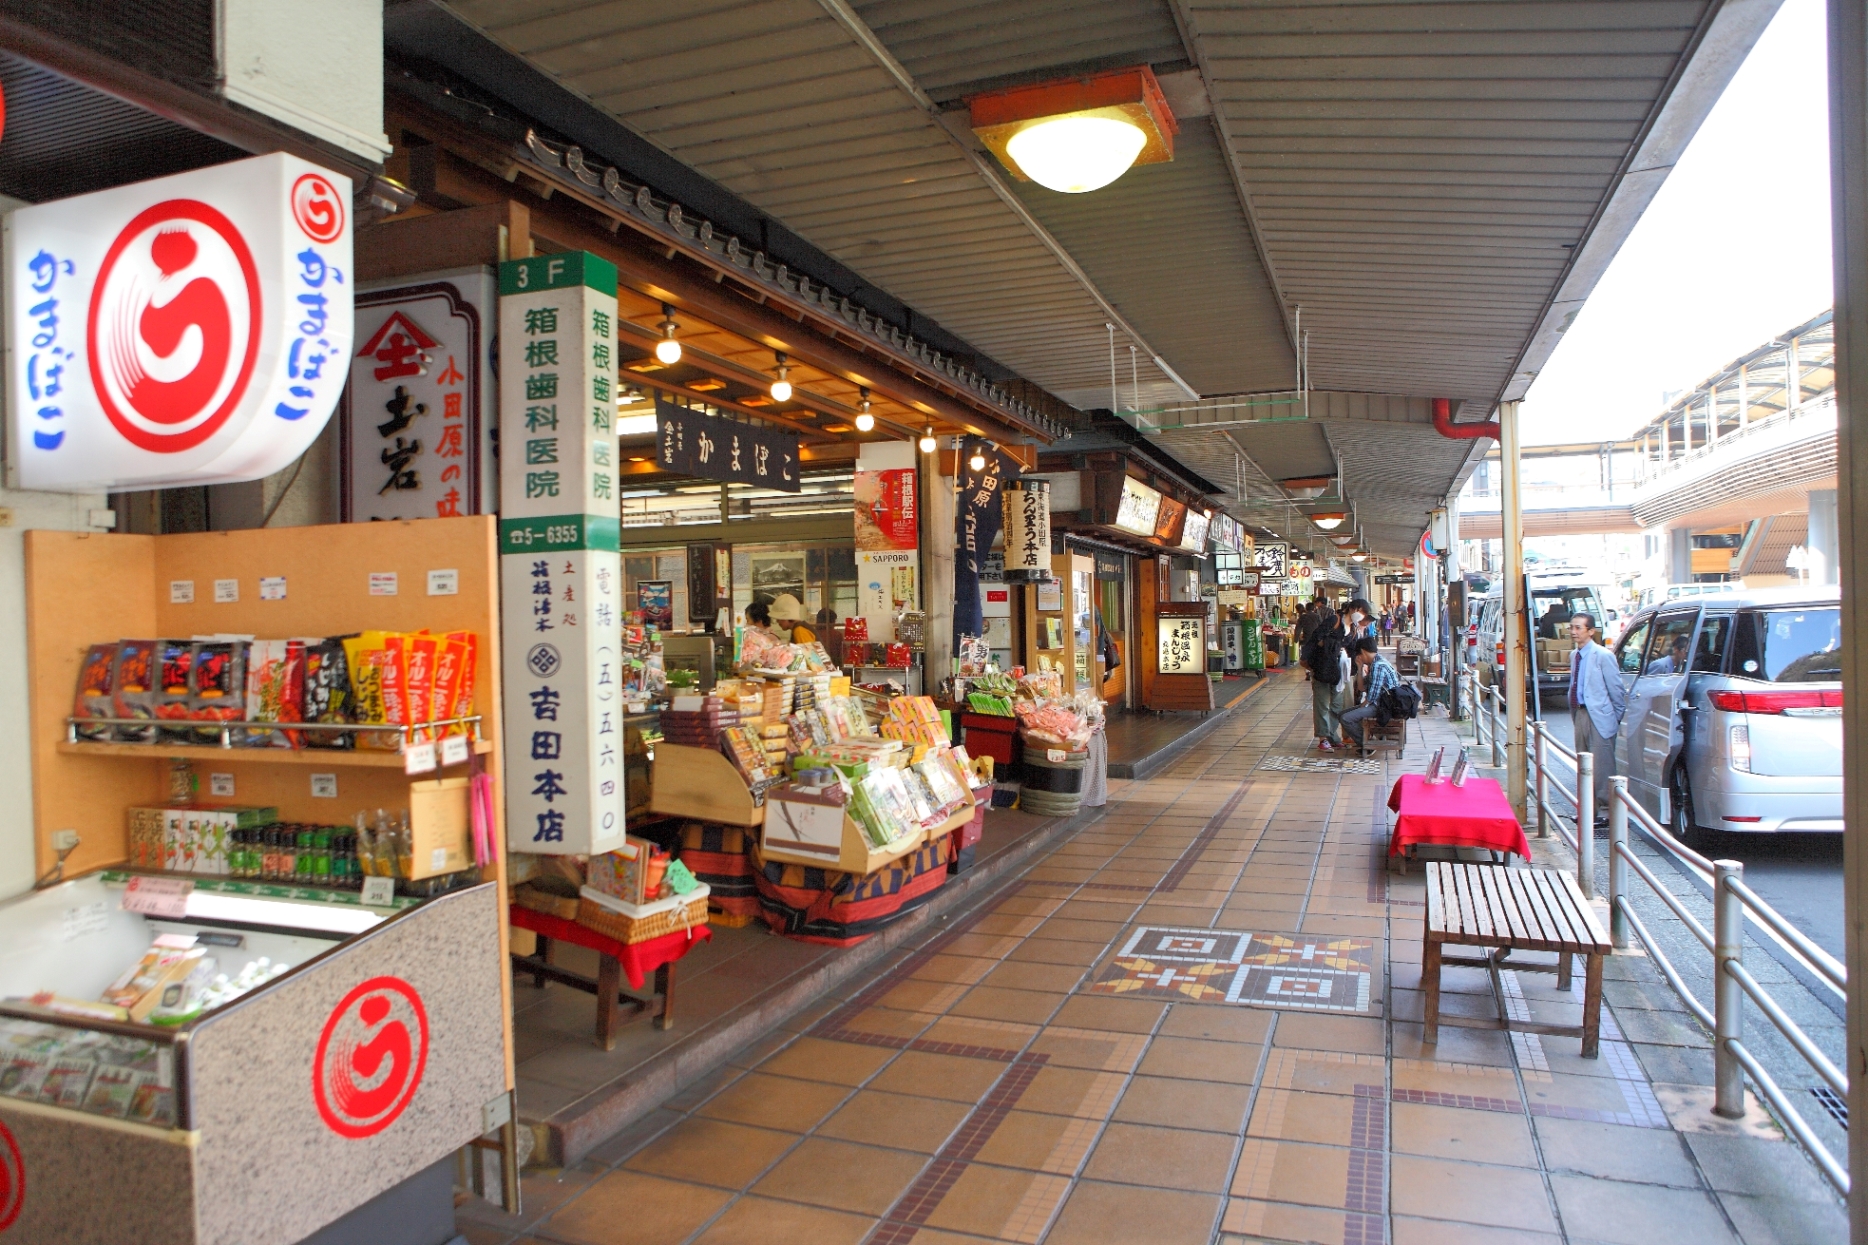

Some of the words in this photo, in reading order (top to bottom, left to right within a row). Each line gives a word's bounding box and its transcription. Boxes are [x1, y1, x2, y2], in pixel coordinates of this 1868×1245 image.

[28, 248, 75, 450] かまぼこ
[275, 248, 344, 420] かまぼこ
[524, 307, 560, 499] 箱根歯科医院
[593, 309, 612, 500] 箱根歯科医院
[698, 431, 792, 481] かまぼこ
[902, 472, 914, 520] 箱根駅伝
[1023, 490, 1039, 566] ちん里う本店
[562, 560, 577, 627] 土産処
[872, 554, 909, 563] SAPPORO
[530, 561, 554, 632] 箱根湯本
[1171, 629, 1181, 670] まんじゅう
[529, 686, 567, 842] 吉田本店
